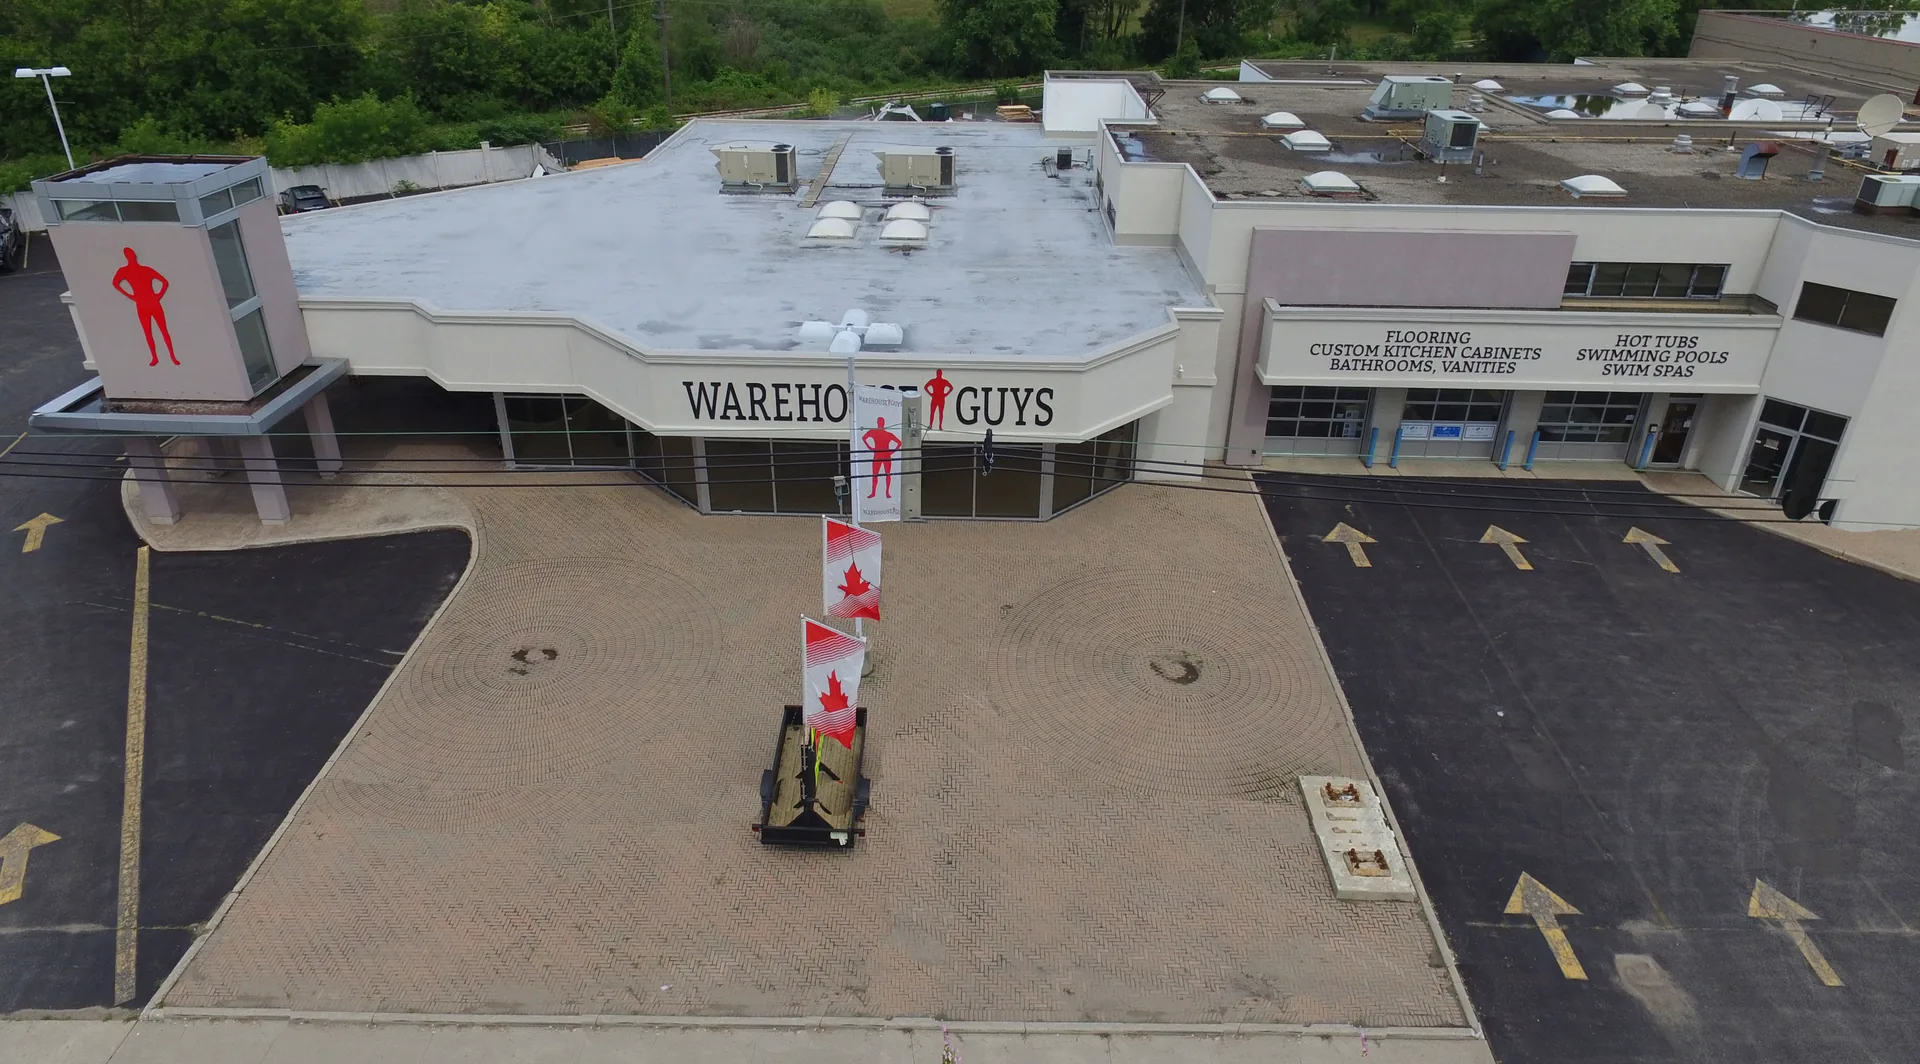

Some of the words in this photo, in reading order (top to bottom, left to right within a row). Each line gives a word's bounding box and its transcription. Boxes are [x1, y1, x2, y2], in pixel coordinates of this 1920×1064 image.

[1385, 330, 1471, 344] FLOORING
[1615, 334, 1652, 347] HOT
[1655, 336, 1699, 348] TUBS
[1309, 343, 1380, 356] CUSTOM
[1383, 345, 1456, 358] KITCHEN
[1461, 346, 1542, 360] CABINETS
[1576, 348, 1671, 362] SWIMMING
[1674, 350, 1729, 364] POOLS
[1329, 358, 1436, 374] BATHROOMS,
[1441, 360, 1517, 374] VANITIES
[1602, 363, 1650, 376] SWIM
[1653, 365, 1695, 378] SPAS
[682, 381, 918, 423] WAREHO
[955, 386, 1054, 427] GUYS
